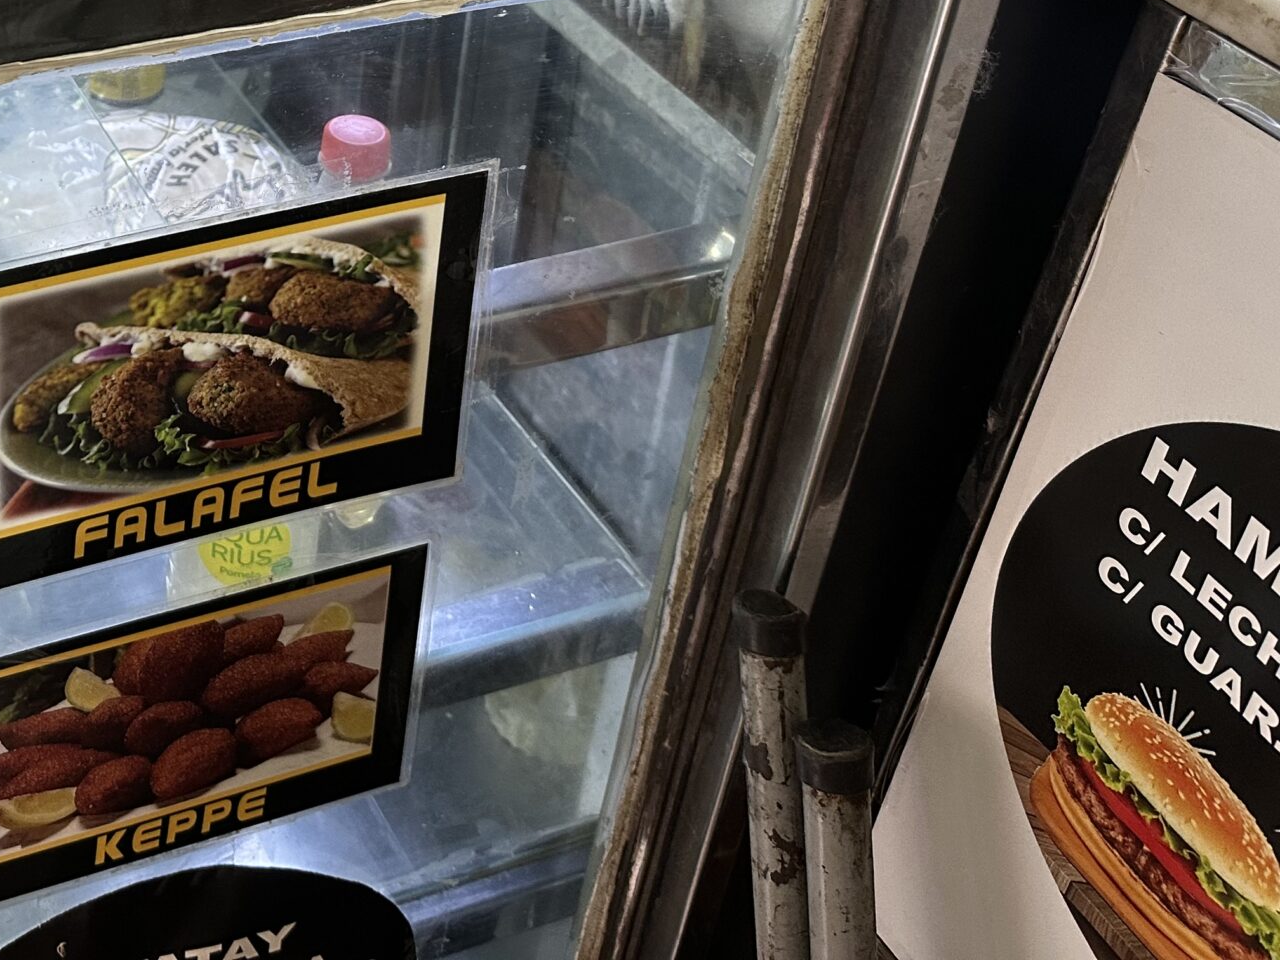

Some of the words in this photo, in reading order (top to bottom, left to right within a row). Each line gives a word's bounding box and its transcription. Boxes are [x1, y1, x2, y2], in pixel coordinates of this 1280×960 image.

[74, 461, 338, 558] FALAFEL
[1118, 507, 1166, 556] C/
[211, 542, 272, 567] RIUS
[1097, 556, 1145, 604] C/
[1150, 603, 1280, 754] GUAR
[93, 786, 268, 865] KEPPE
